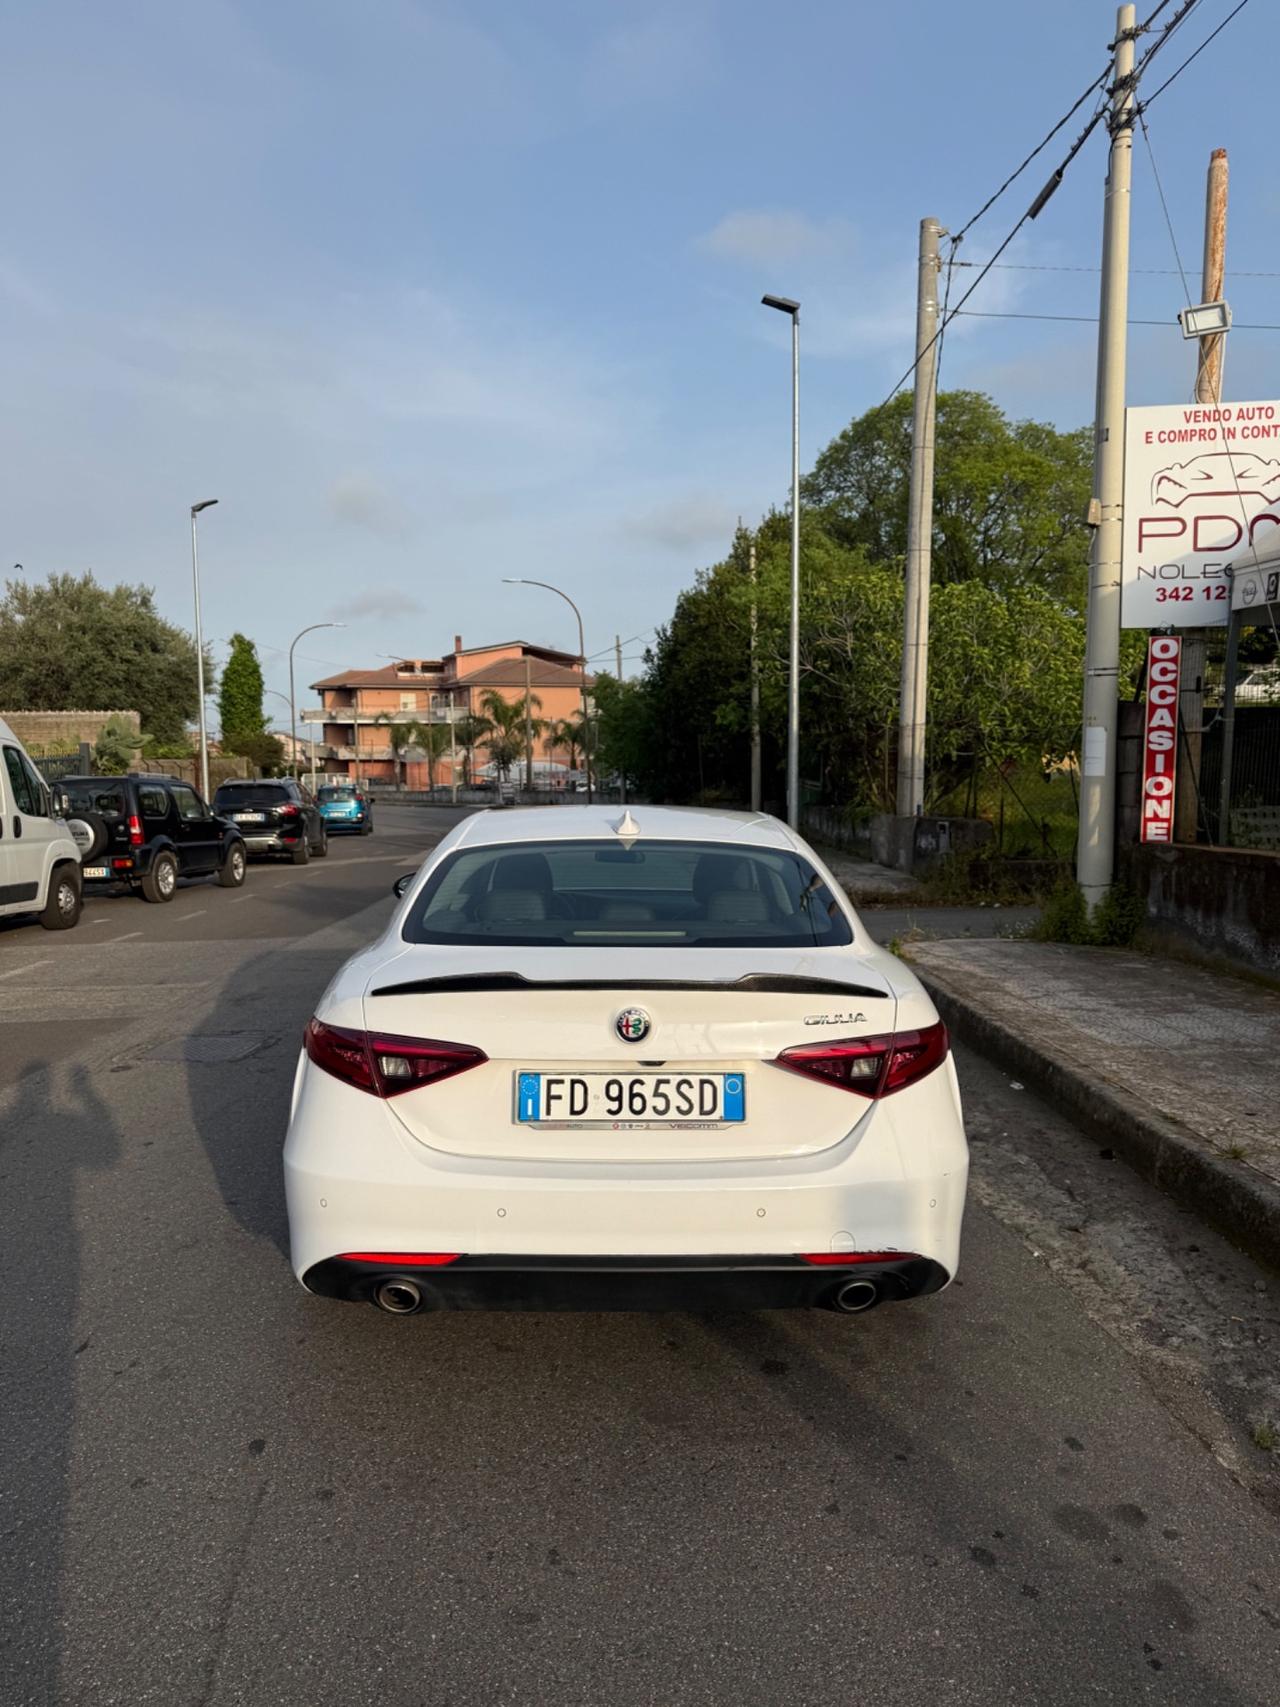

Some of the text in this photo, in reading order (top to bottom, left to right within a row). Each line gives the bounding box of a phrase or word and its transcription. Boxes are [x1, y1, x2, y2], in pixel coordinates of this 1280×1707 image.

[1183, 406, 1275, 424] VENDO AUTO
[1145, 424, 1280, 444] E COMPRO IN CONT
[1155, 586, 1194, 602] 342
[1145, 638, 1178, 841] OCCASIONE
[803, 1012, 868, 1025] GIULIA
[545, 1078, 589, 1116] FD
[604, 1078, 718, 1116] 965SD
